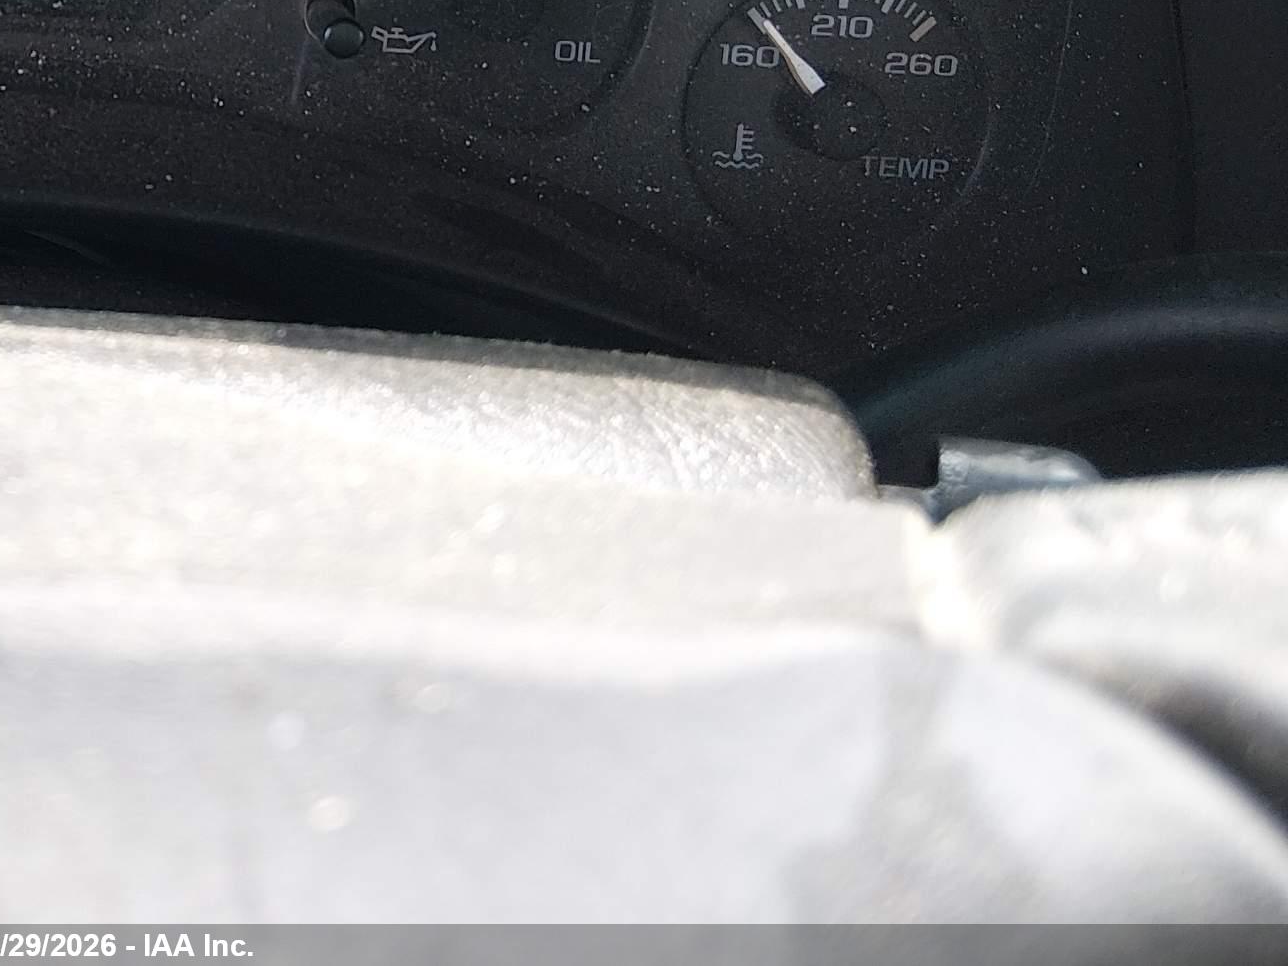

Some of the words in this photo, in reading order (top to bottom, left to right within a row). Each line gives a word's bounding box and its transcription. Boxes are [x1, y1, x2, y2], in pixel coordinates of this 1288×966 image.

[810, 15, 874, 38] 210
[554, 40, 601, 65] OIL
[720, 44, 780, 66] 160
[885, 54, 958, 77] 260
[861, 155, 949, 180] TEMP
